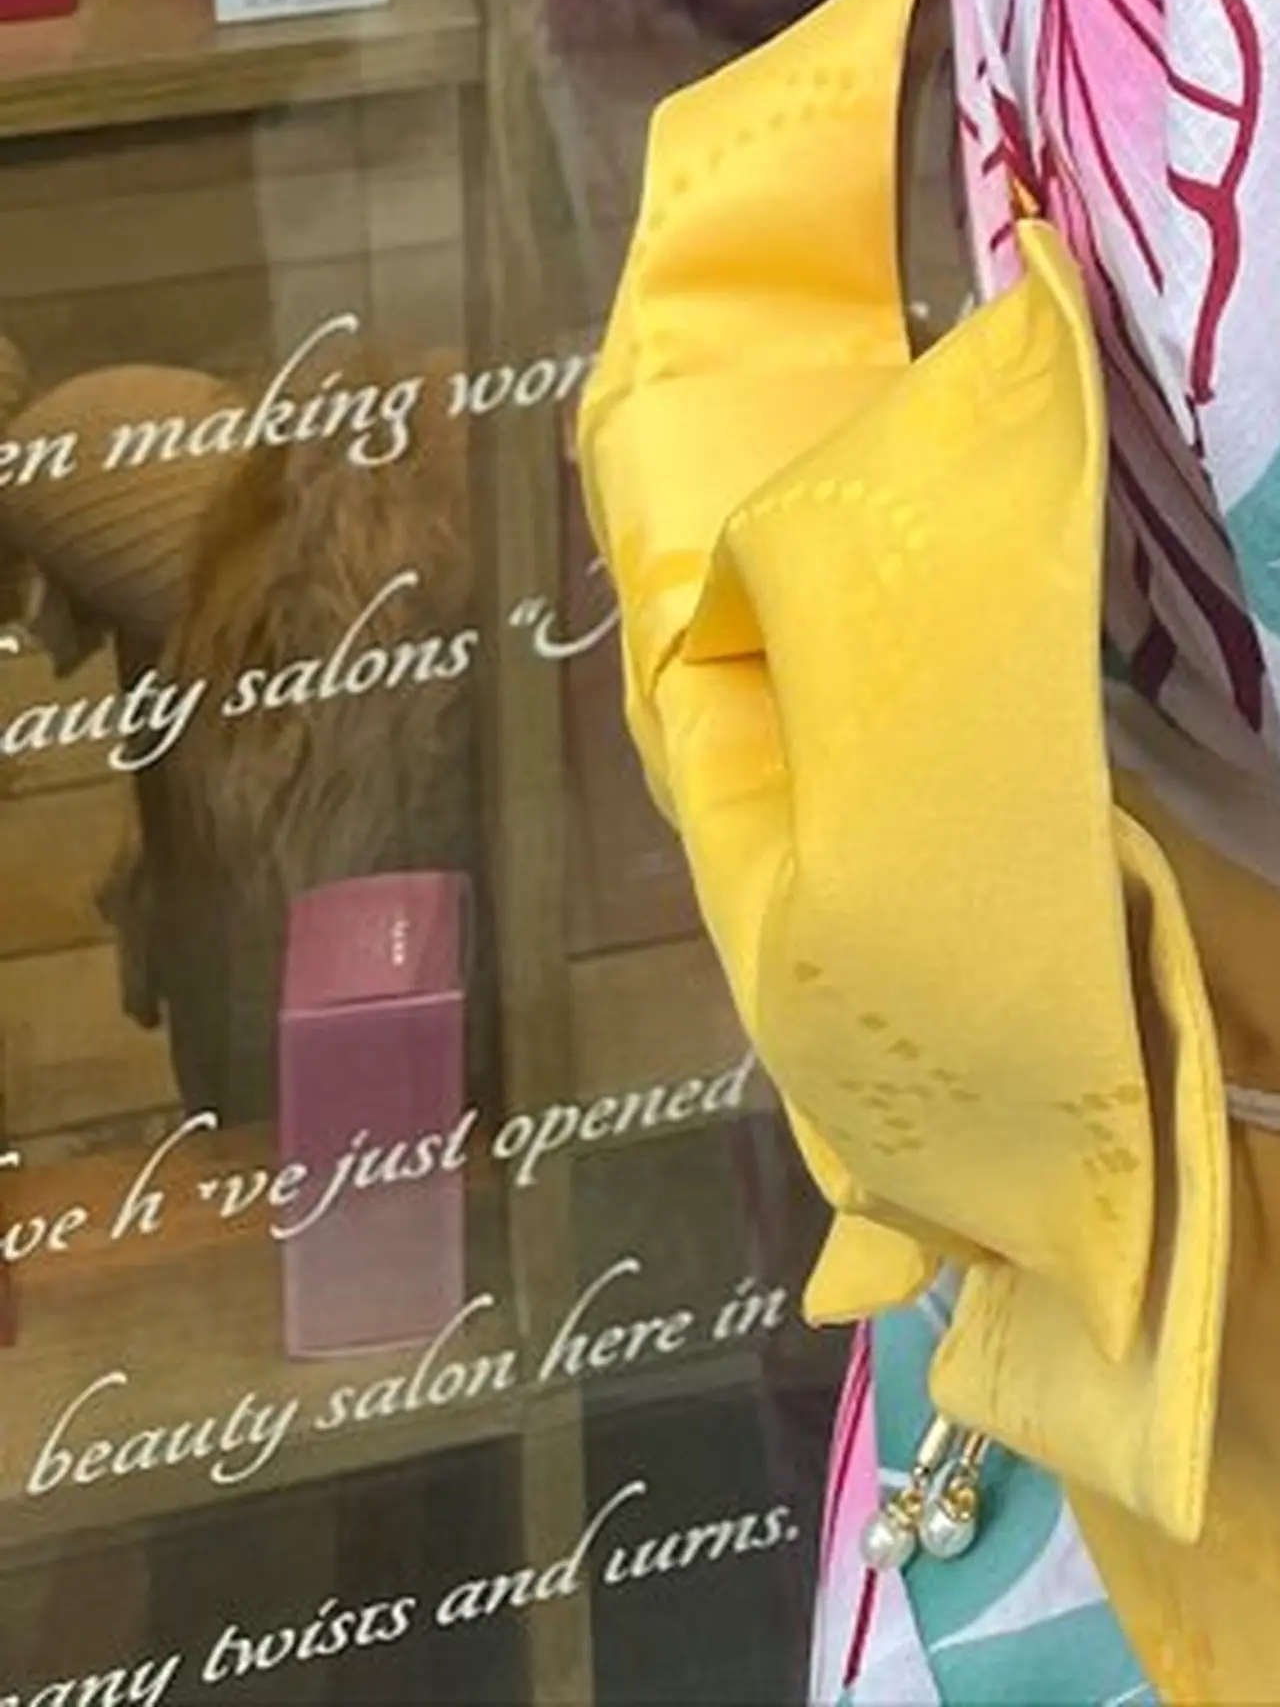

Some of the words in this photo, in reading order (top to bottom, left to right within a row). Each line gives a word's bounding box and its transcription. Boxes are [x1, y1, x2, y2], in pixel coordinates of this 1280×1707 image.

[103, 313, 426, 468] making
[221, 571, 479, 718] salons
[269, 1106, 479, 1240] just
[492, 1050, 757, 1187] opened
[26, 1371, 299, 1496] beauty
[313, 1292, 517, 1432] salon
[539, 1257, 694, 1382] here
[712, 1275, 788, 1340] in
[202, 1597, 417, 1684] twists
[434, 1479, 647, 1627] and
